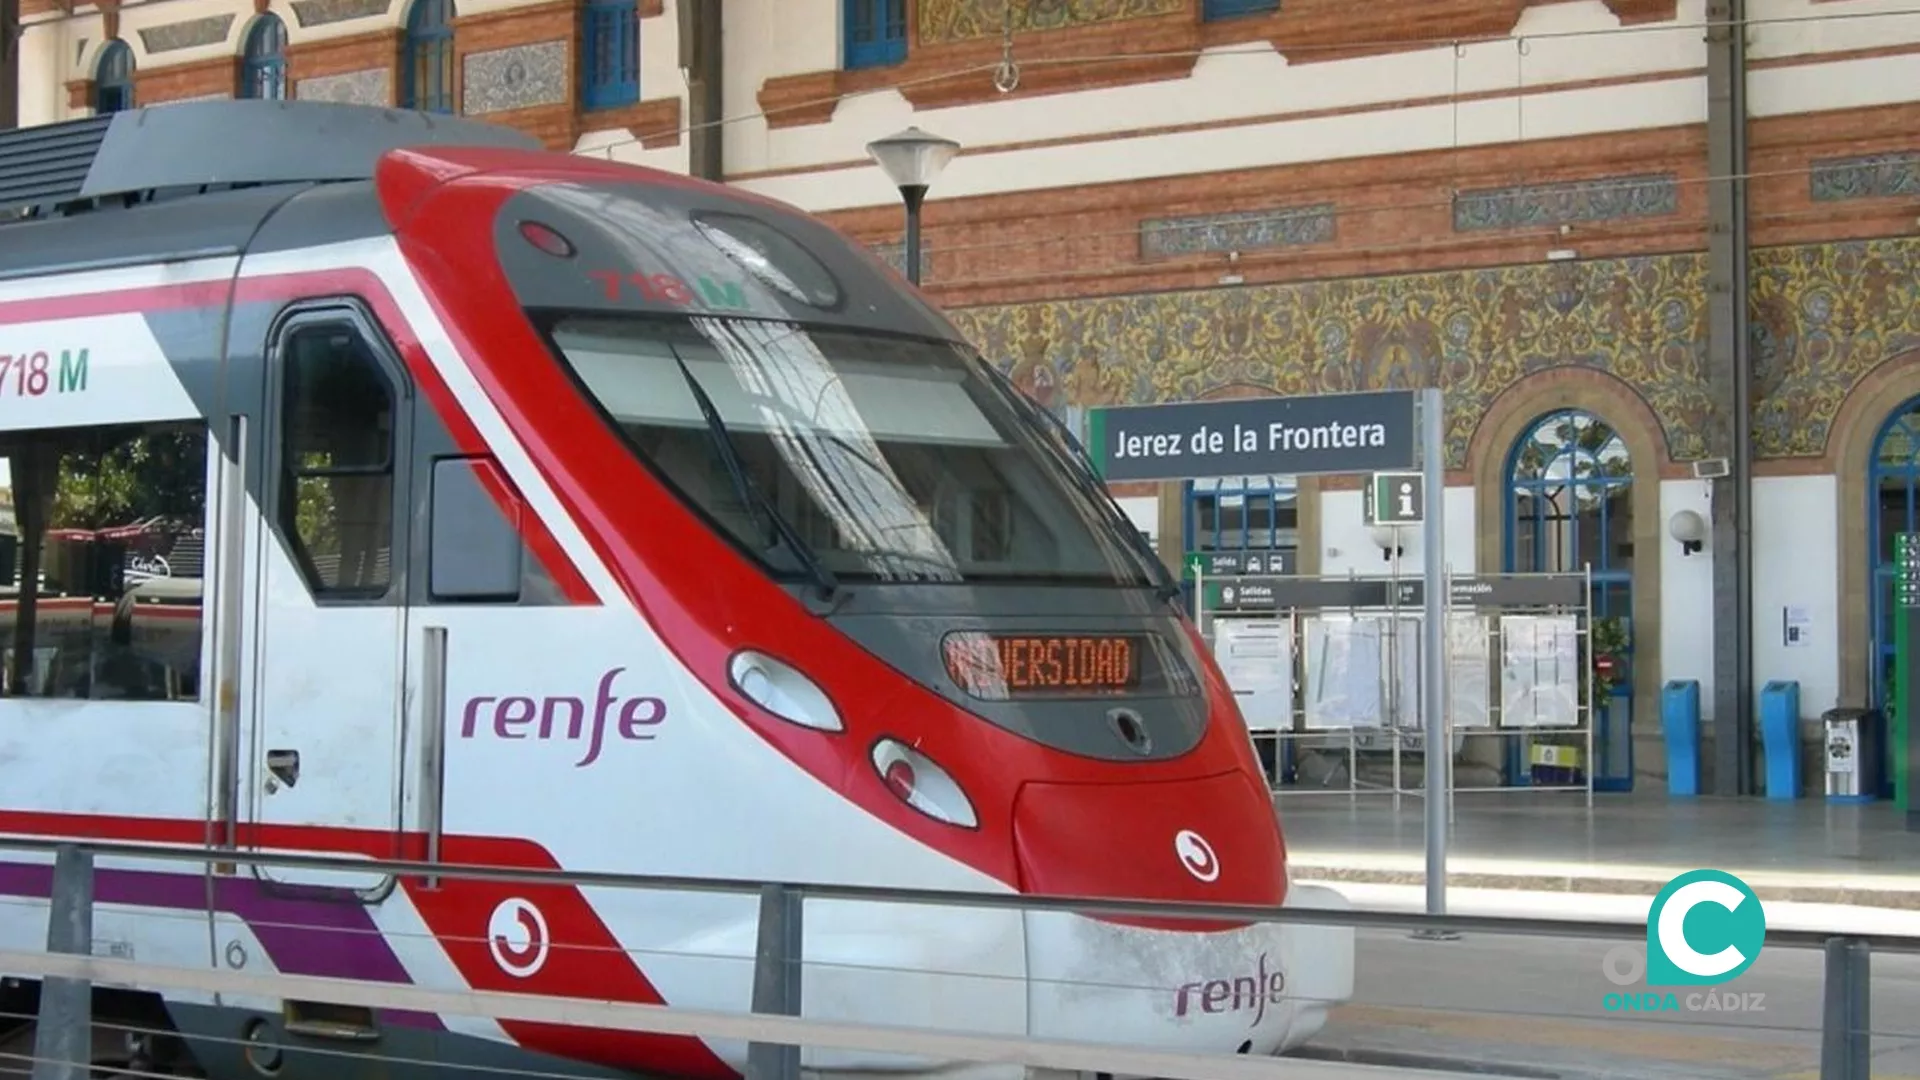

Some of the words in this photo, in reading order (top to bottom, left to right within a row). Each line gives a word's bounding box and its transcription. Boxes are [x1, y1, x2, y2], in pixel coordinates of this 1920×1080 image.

[586, 267, 694, 306] 718
[699, 273, 748, 308] M
[59, 348, 89, 393] M
[1115, 431, 1182, 458] Jerez
[1190, 426, 1223, 455] de
[1234, 424, 1258, 452] la
[1269, 420, 1386, 451] Frontera
[461, 667, 667, 768] renfe
[1175, 951, 1285, 1028] renfe
